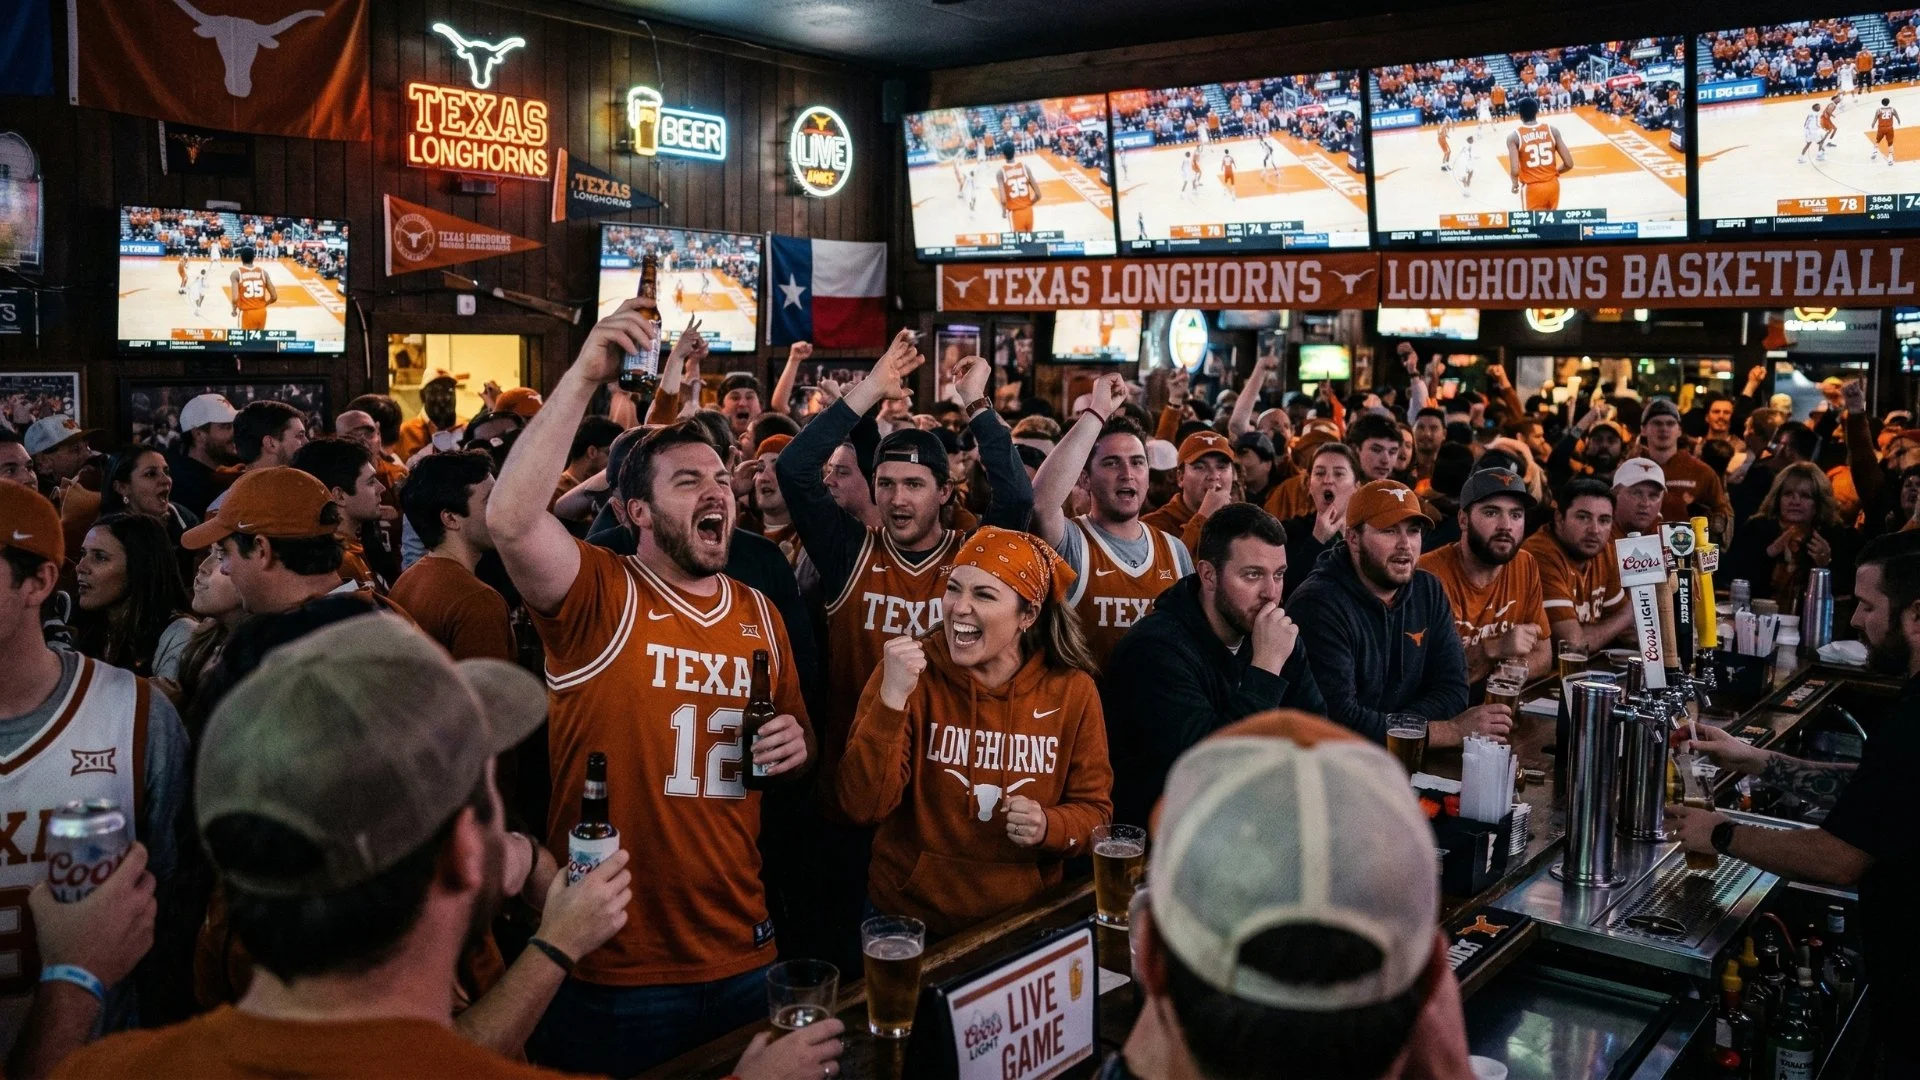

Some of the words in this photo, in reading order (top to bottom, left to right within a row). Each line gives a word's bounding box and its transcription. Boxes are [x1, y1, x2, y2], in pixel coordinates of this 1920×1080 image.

[409, 83, 547, 147] TEXAS
[661, 116, 721, 151] BEER
[409, 134, 548, 176] LONGHORNS
[1525, 142, 1553, 168] 35
[573, 191, 632, 208] LONGHORNS
[575, 172, 631, 199] TEXAS
[1009, 178, 1029, 198] 35
[1488, 214, 1503, 225] 78
[1539, 212, 1554, 224] 74
[1839, 198, 1857, 212] 78
[439, 231, 464, 242] TEXAS
[1249, 224, 1262, 235] 74
[242, 280, 263, 298] 35
[984, 267, 1090, 306] TEXAS
[1101, 260, 1322, 305] LONGHORNS
[1387, 255, 1608, 300] LONGHORNS
[1621, 247, 1915, 298] BASKETBALL
[249, 331, 261, 340] 74
[1622, 556, 1660, 570] Coors
[863, 592, 944, 636] TEXA
[1093, 596, 1156, 628] TEX
[1639, 590, 1653, 627] LIGHT
[1646, 629, 1660, 662] Coors
[646, 643, 751, 698] TEXA
[664, 703, 748, 800] 12
[926, 722, 1059, 774] LONGHORNS
[1008, 971, 1057, 1034] LIVE
[964, 1016, 1003, 1049] Coors
[968, 1036, 1000, 1061] LIGHT
[1002, 1013, 1064, 1080] GAME
